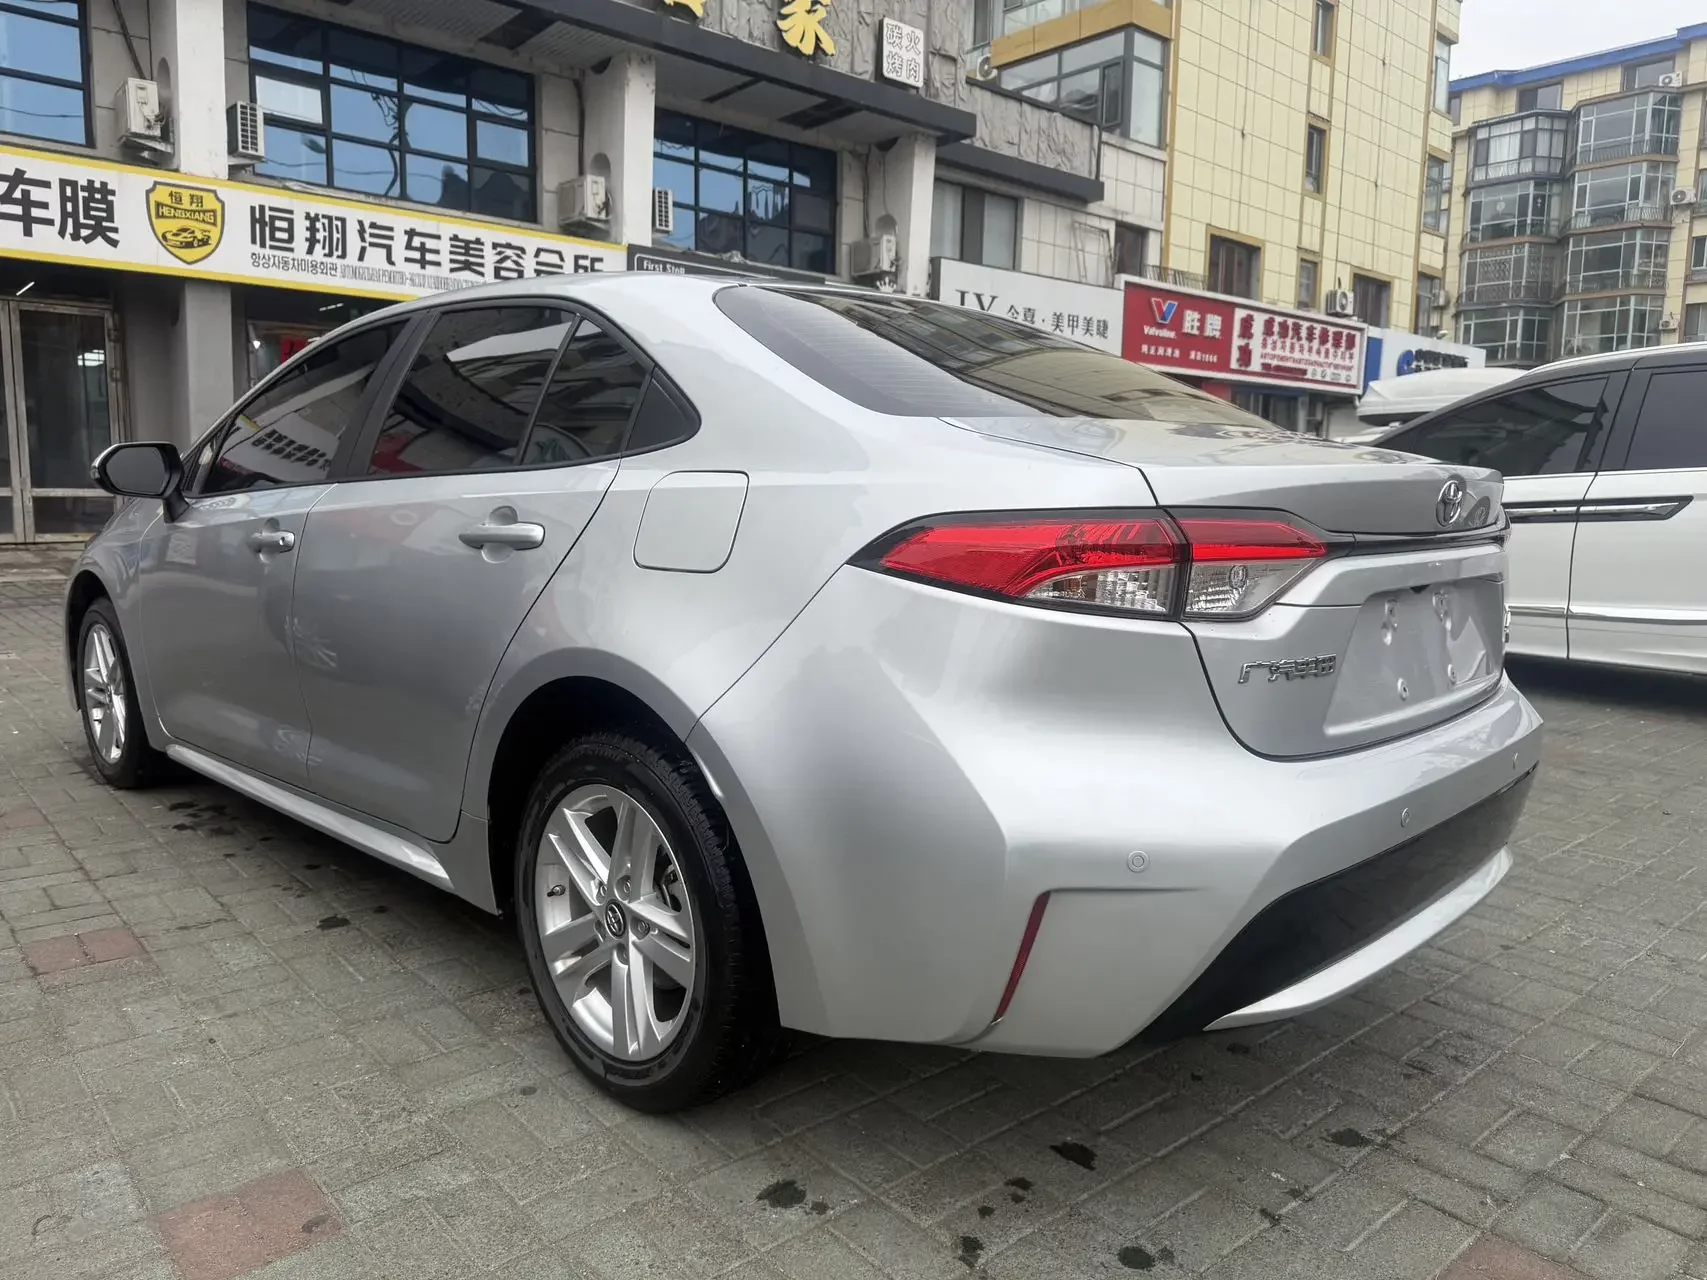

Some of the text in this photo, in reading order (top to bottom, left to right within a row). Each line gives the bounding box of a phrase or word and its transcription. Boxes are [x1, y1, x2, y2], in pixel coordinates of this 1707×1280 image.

[885, 22, 922, 56] 碳火
[885, 50, 921, 83] 烤肉
[0, 167, 121, 249] 车膜
[158, 204, 215, 223] HENGXIANG
[168, 190, 204, 208] 恒翔
[250, 251, 338, 277] 항상자동차미용회관
